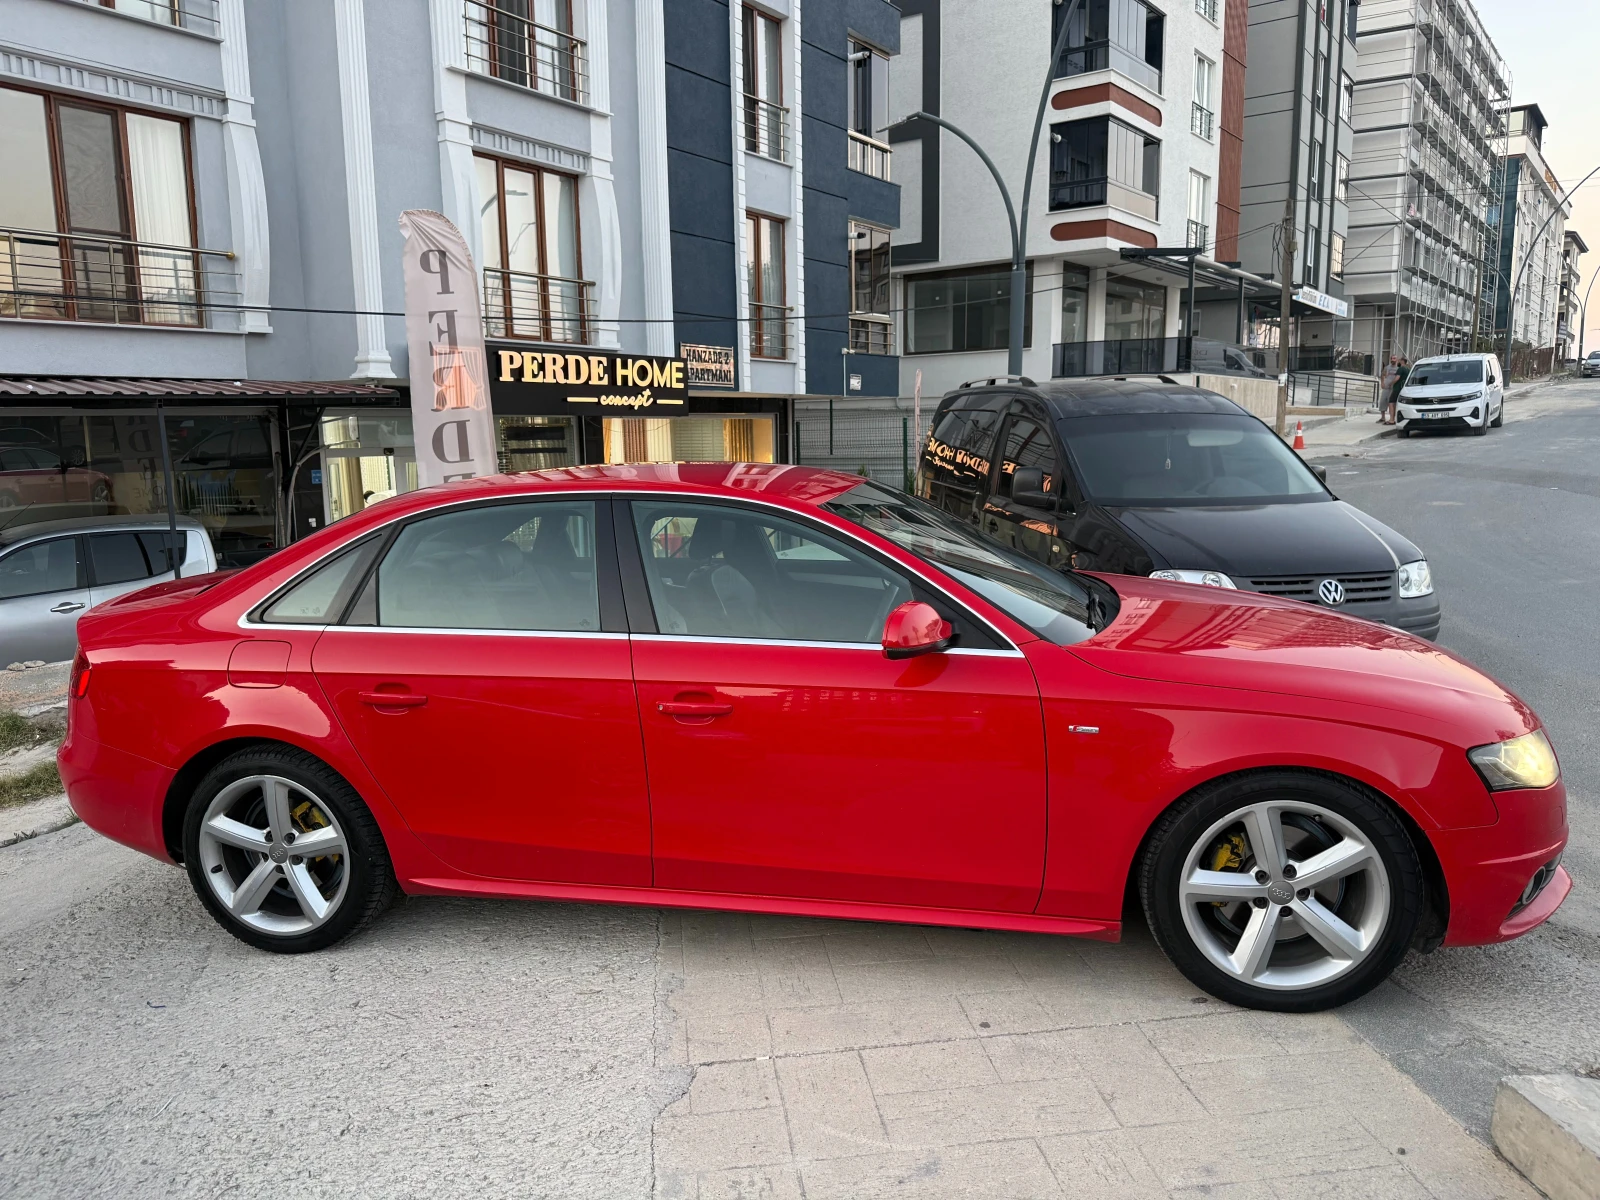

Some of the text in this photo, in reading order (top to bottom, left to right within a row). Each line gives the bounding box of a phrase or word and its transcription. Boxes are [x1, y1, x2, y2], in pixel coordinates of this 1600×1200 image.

[685, 348, 723, 365] HANZADE
[498, 350, 685, 389] PERDE HOME
[687, 367, 732, 383] PARTMANI
[600, 388, 654, 411] concept
